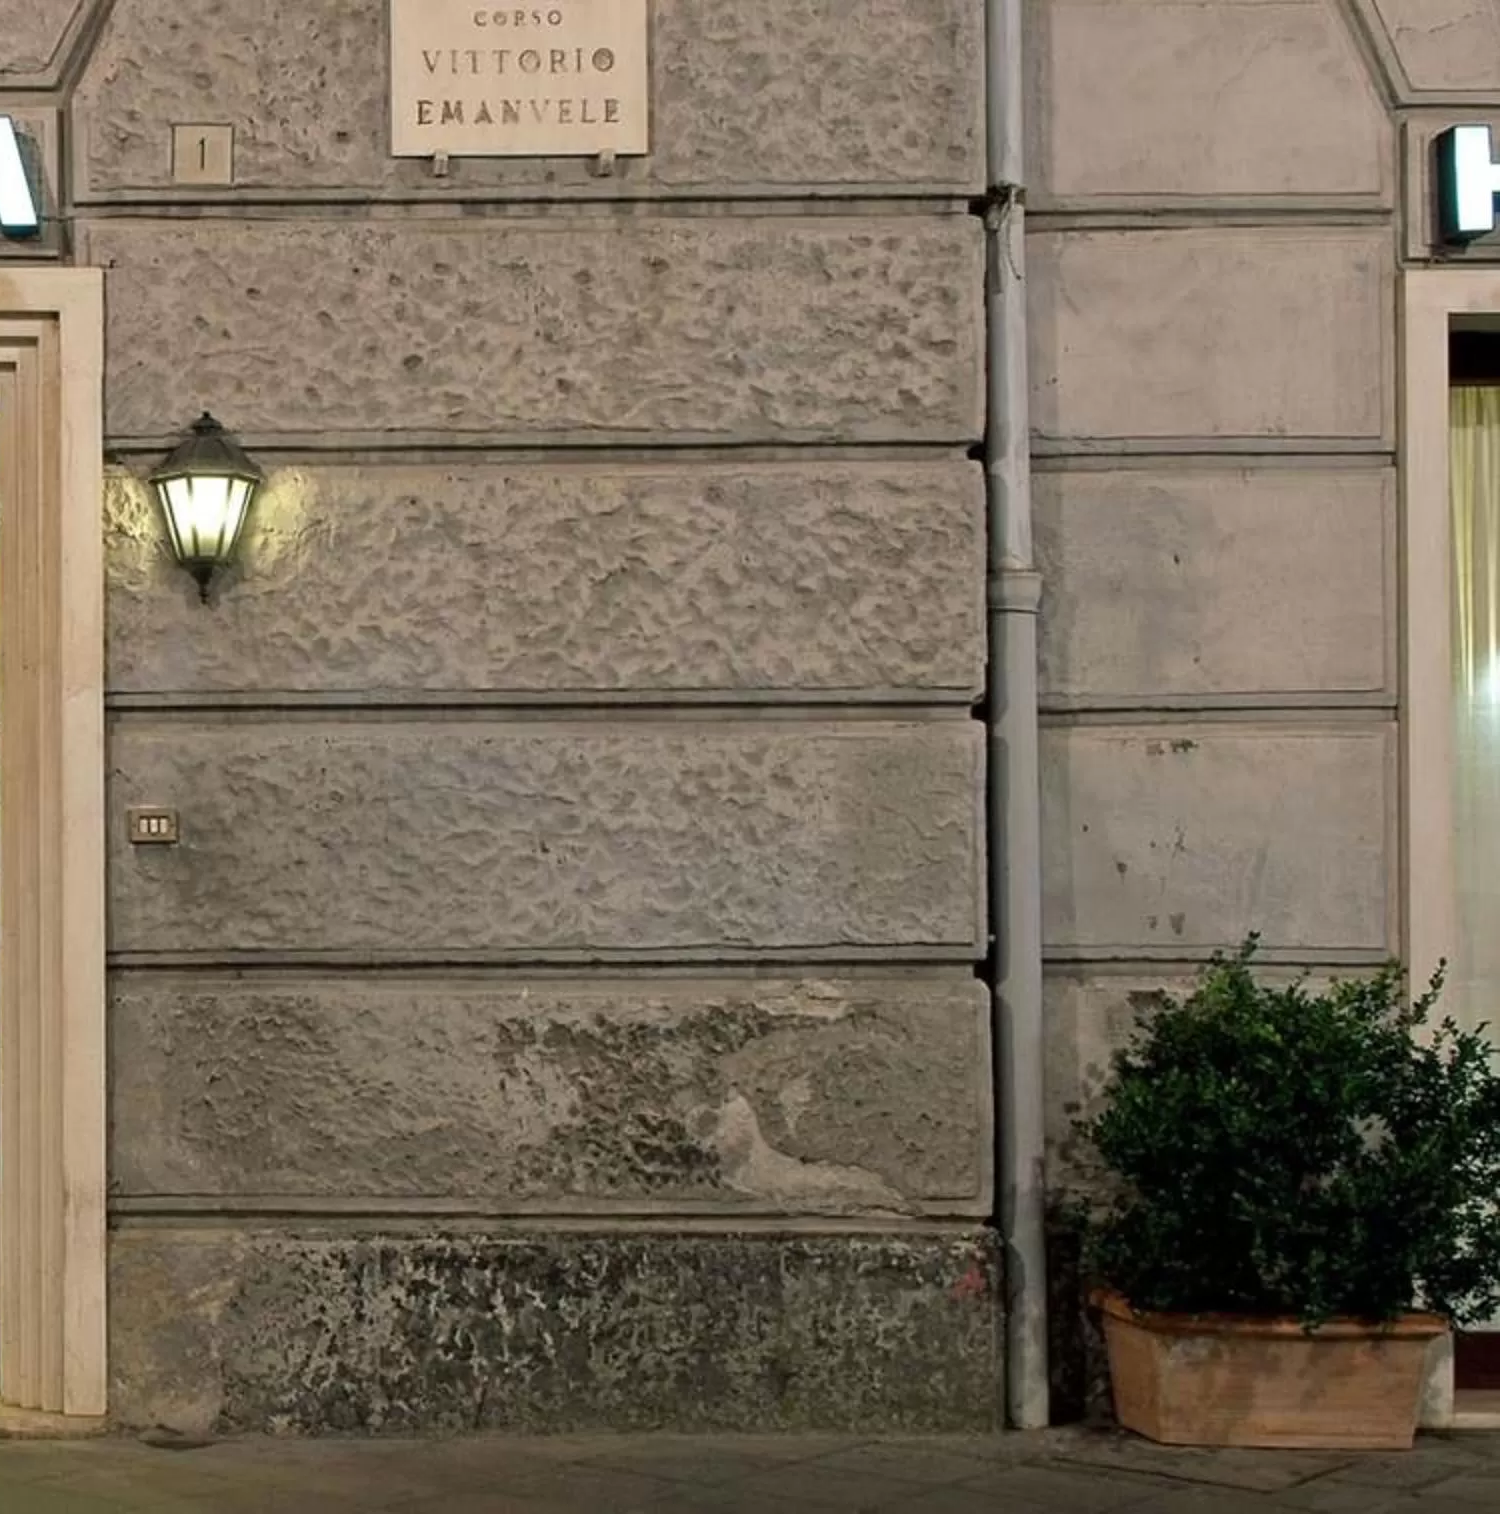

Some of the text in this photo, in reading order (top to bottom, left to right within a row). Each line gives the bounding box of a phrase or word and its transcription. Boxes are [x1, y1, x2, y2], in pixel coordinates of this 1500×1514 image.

[473, 10, 563, 27] CORSO
[422, 48, 615, 74] VITTORIO
[197, 136, 206, 171] 1
